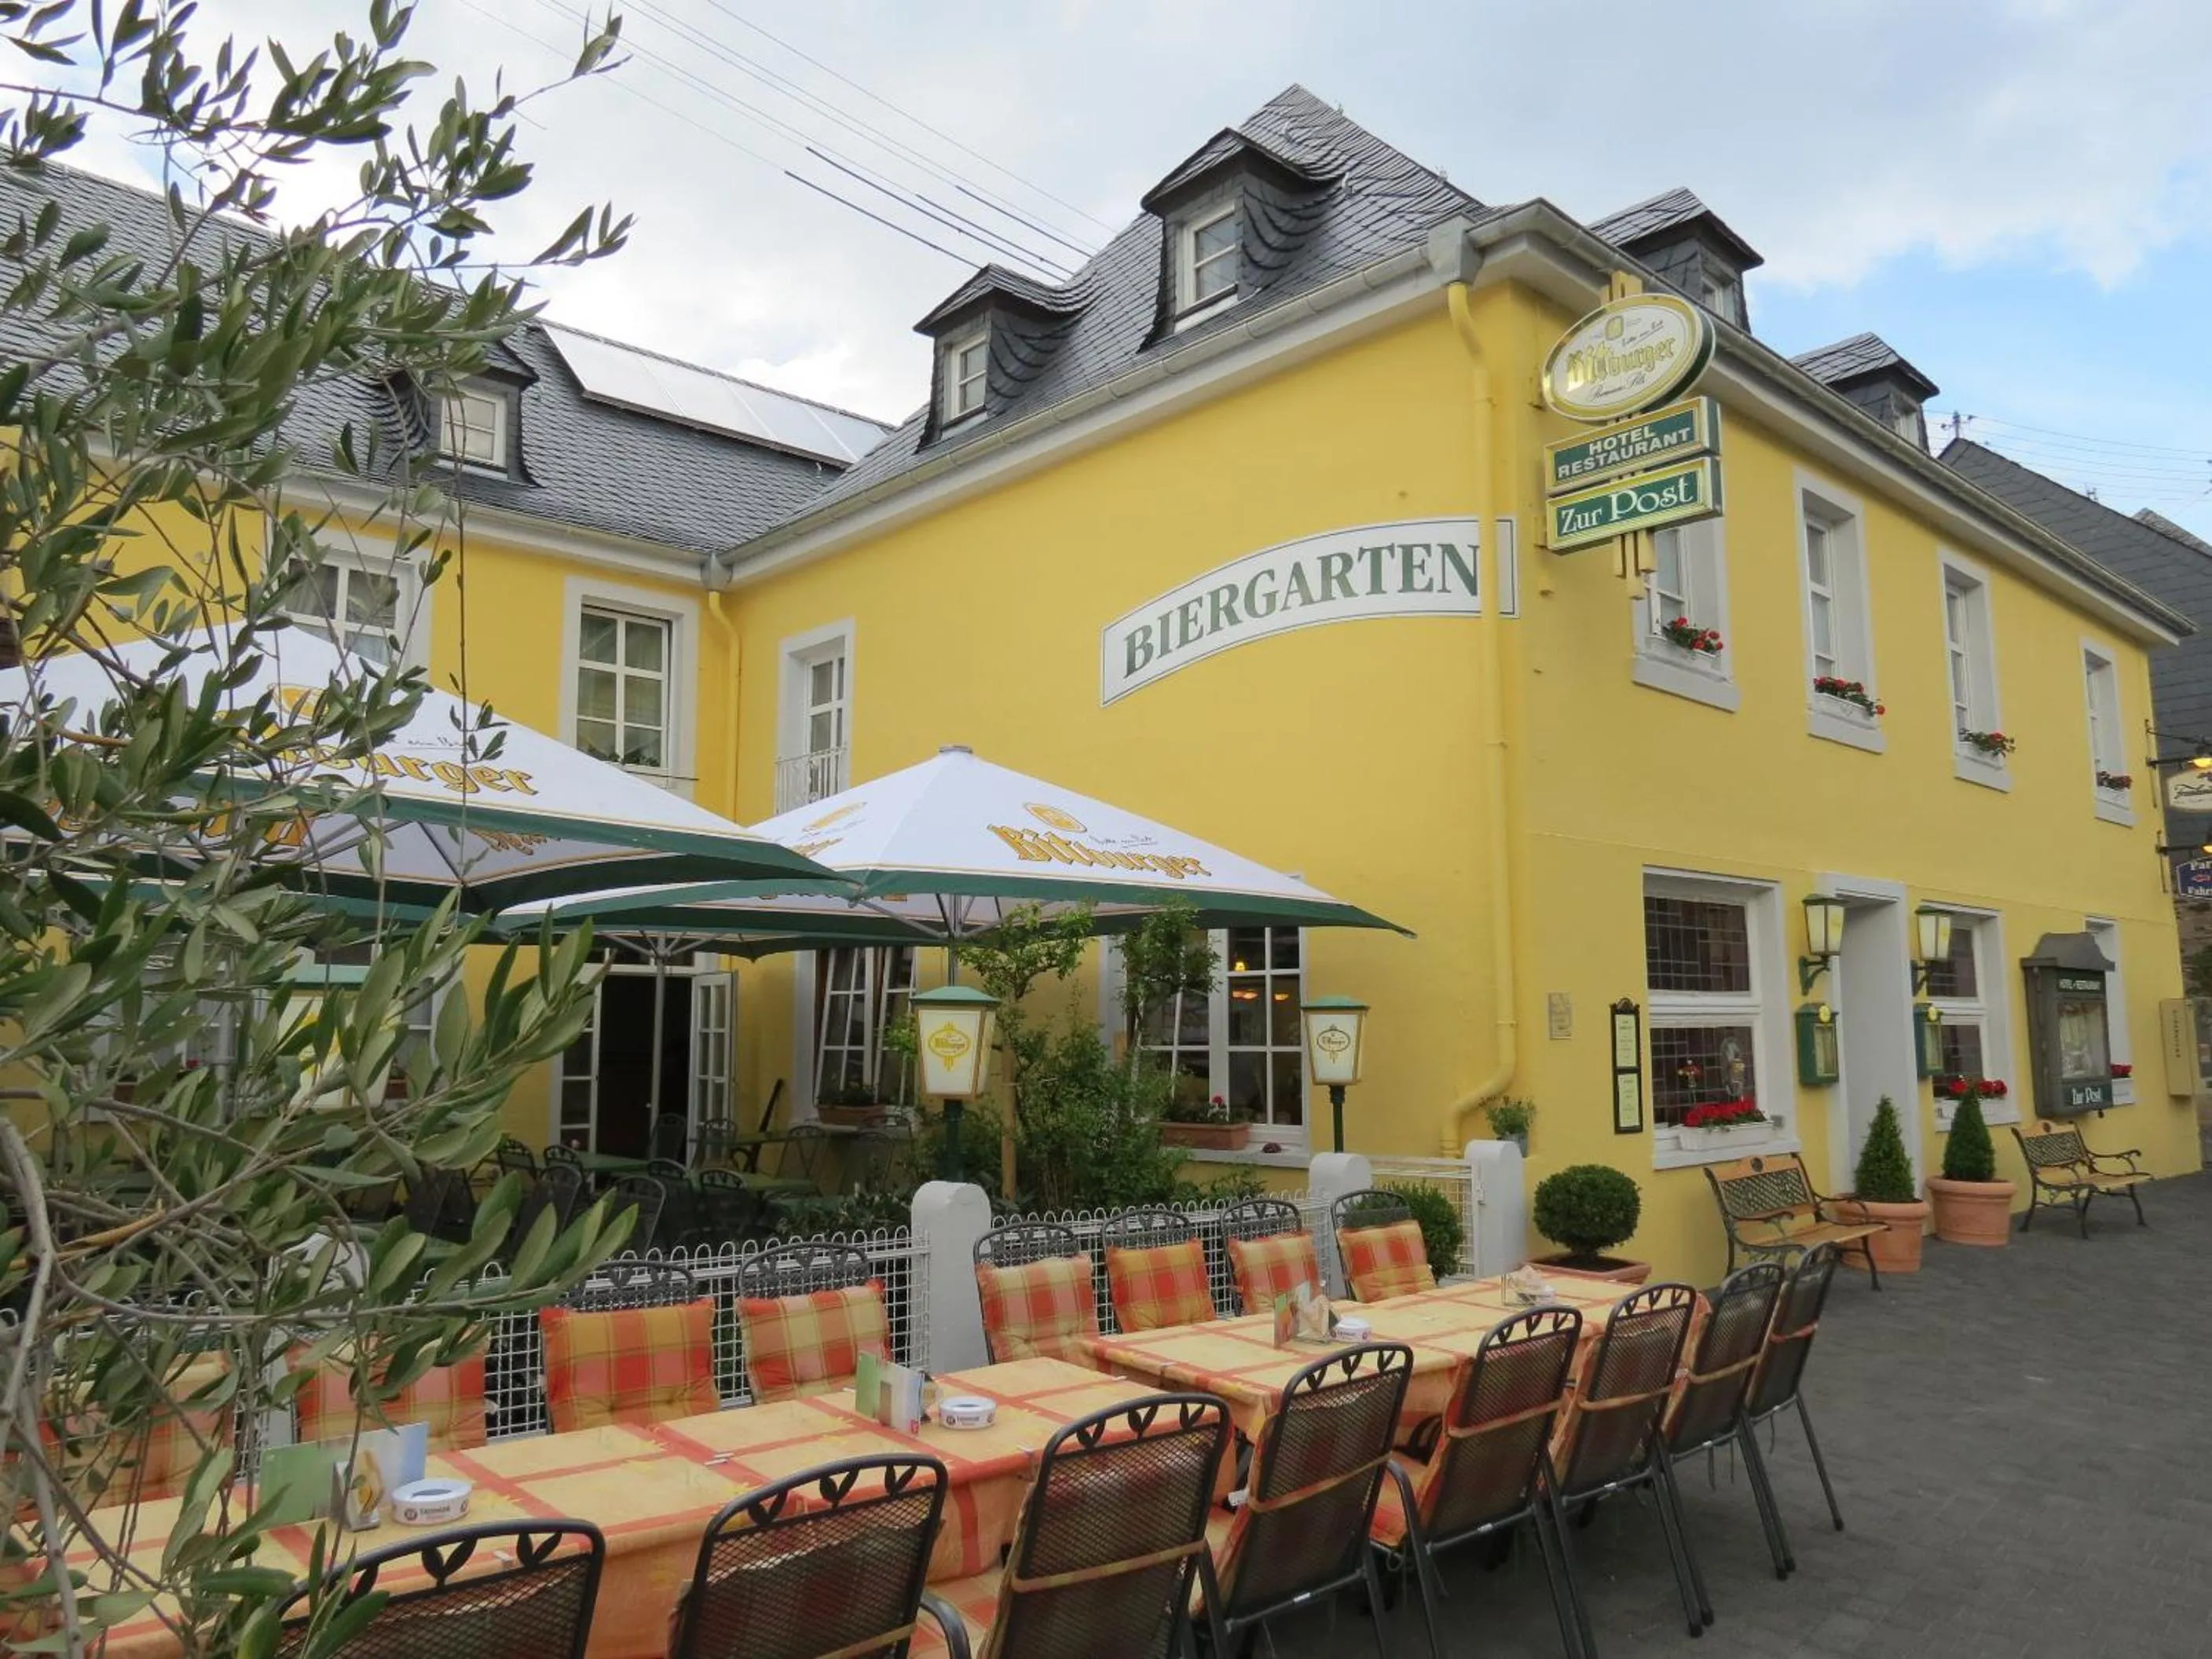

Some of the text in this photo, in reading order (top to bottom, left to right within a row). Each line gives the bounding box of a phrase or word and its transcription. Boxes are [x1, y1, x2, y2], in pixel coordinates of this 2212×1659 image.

[1558, 427, 1691, 478] RESTAURANT
[1588, 426, 1656, 456] HOTEL
[1560, 476, 1694, 535] Zur Post
[1122, 543, 1481, 679] BIERGARTEN
